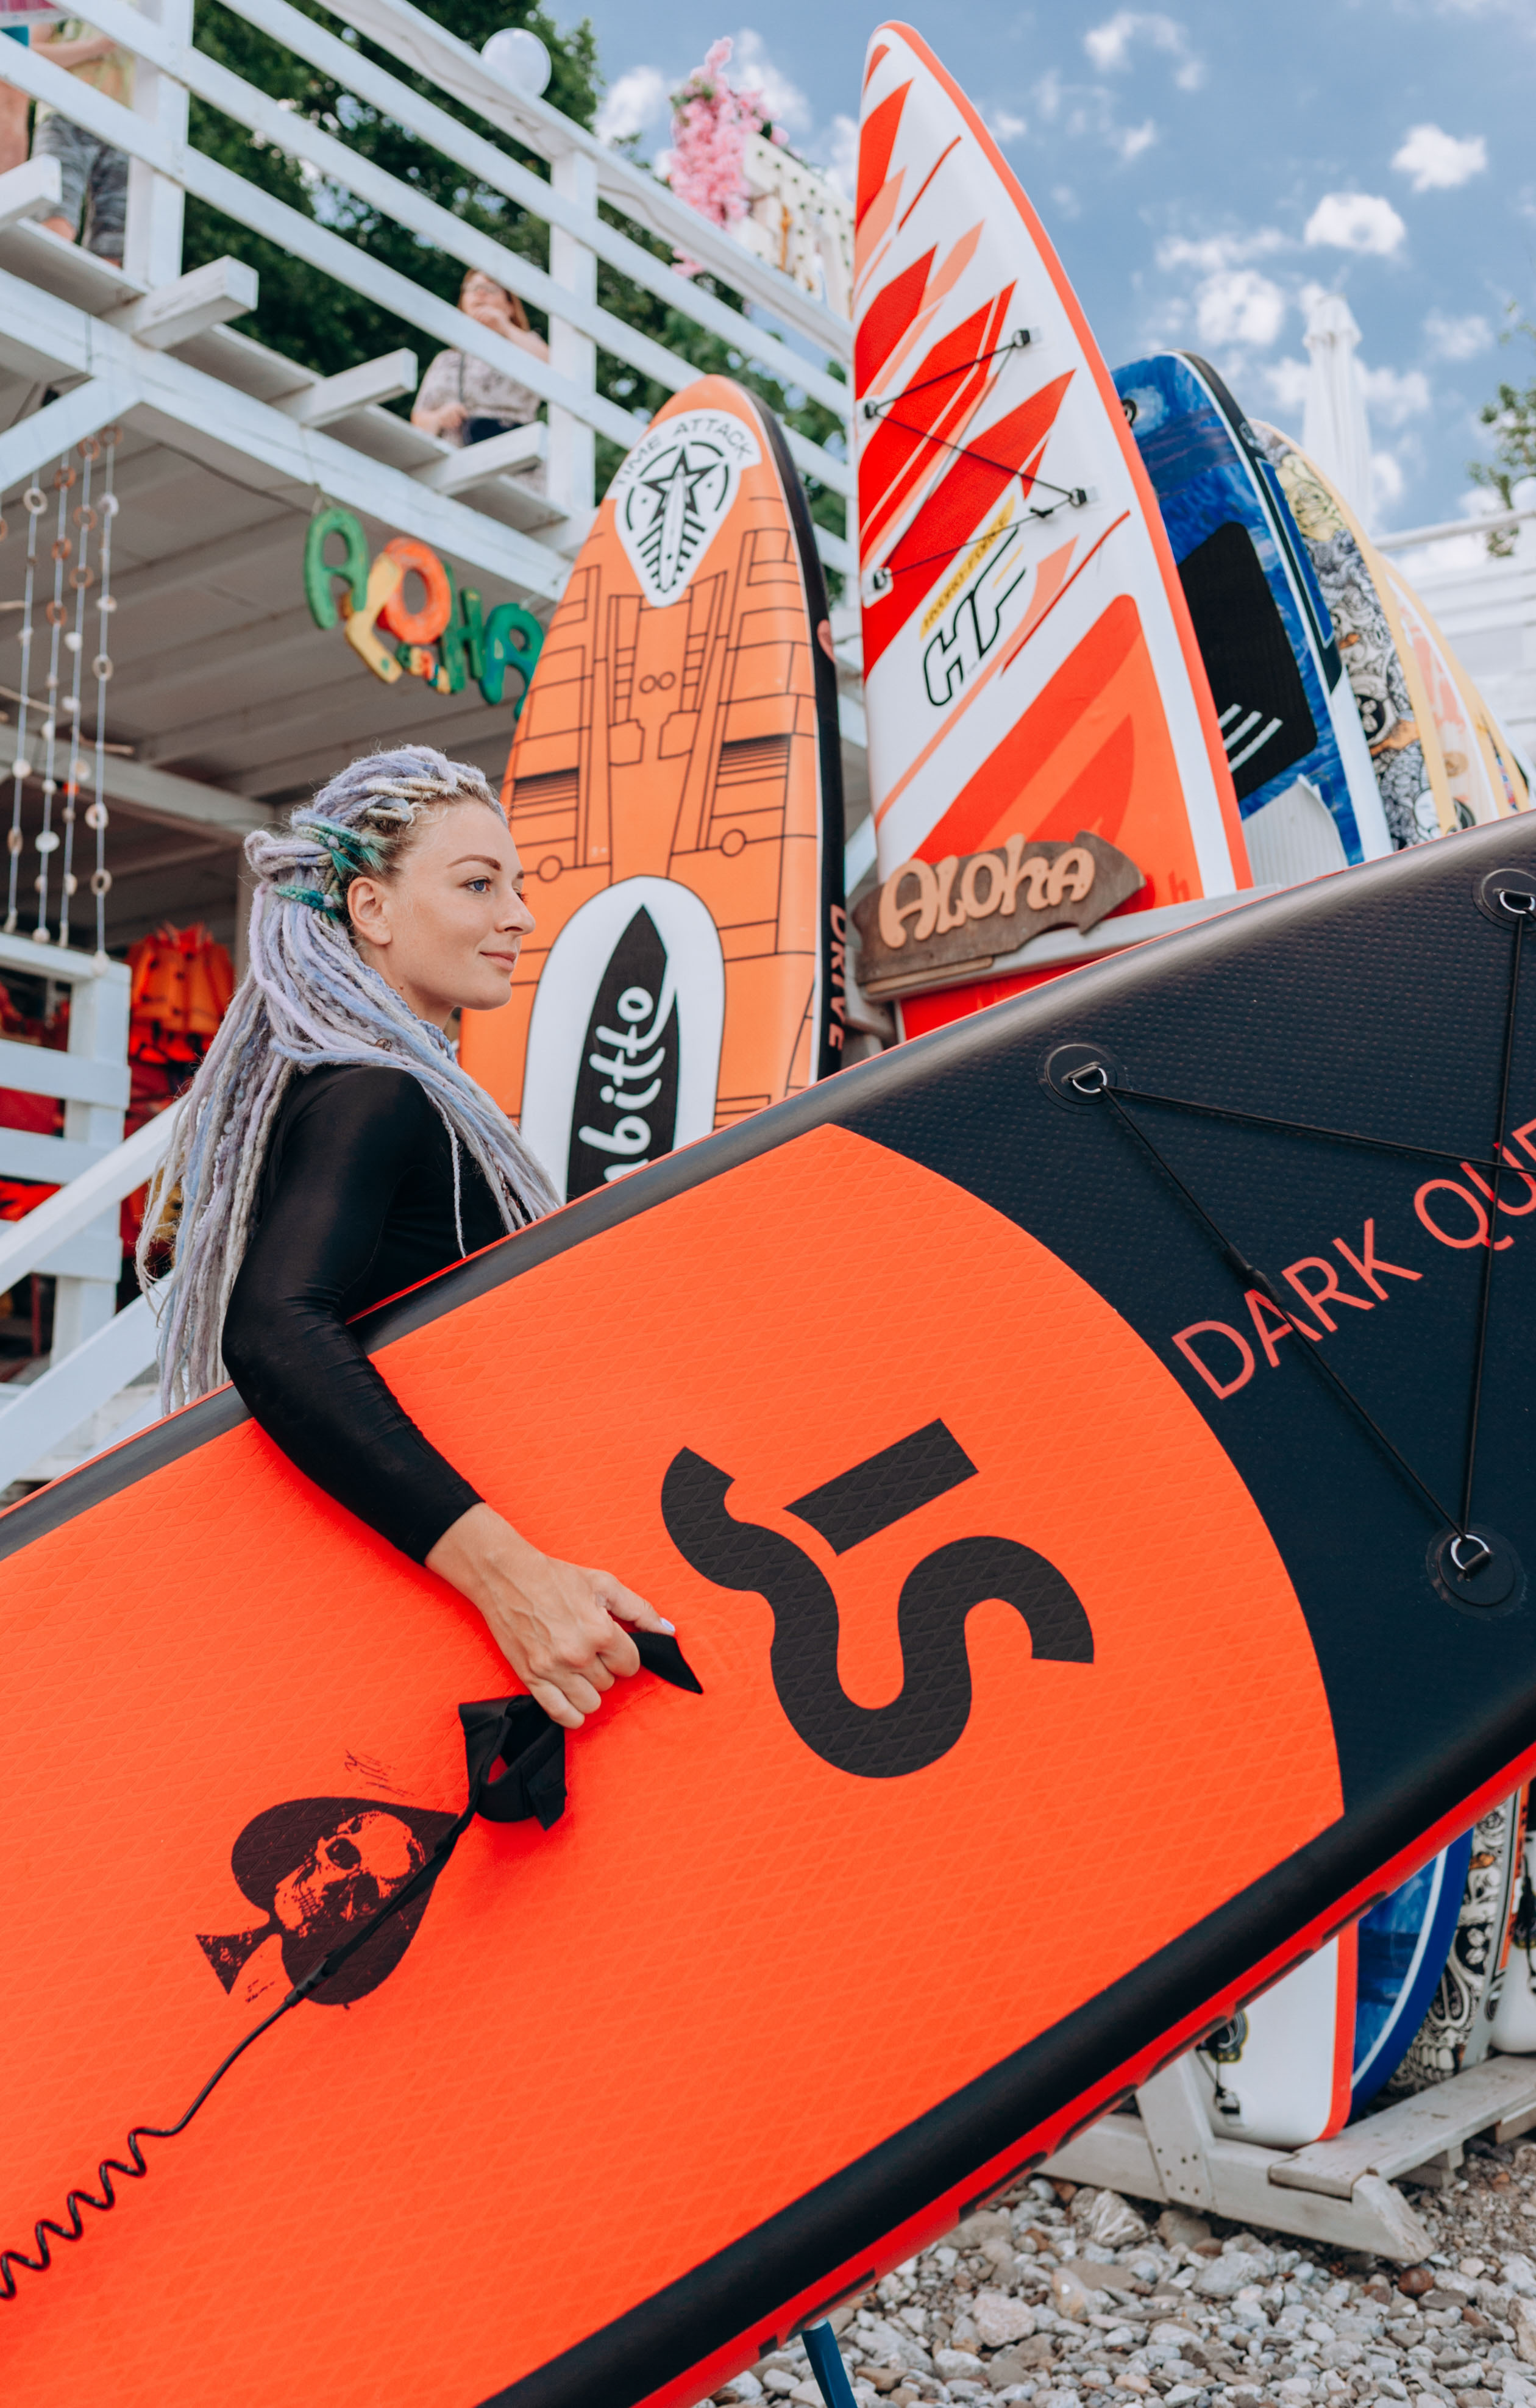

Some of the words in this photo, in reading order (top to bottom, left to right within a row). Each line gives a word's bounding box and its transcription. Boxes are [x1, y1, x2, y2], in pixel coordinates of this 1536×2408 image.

[673, 418, 753, 460] ATTACK
[304, 508, 544, 722] ALOHA
[829, 903, 846, 1050] DRIVE
[1172, 1217, 1423, 1400] DARK
